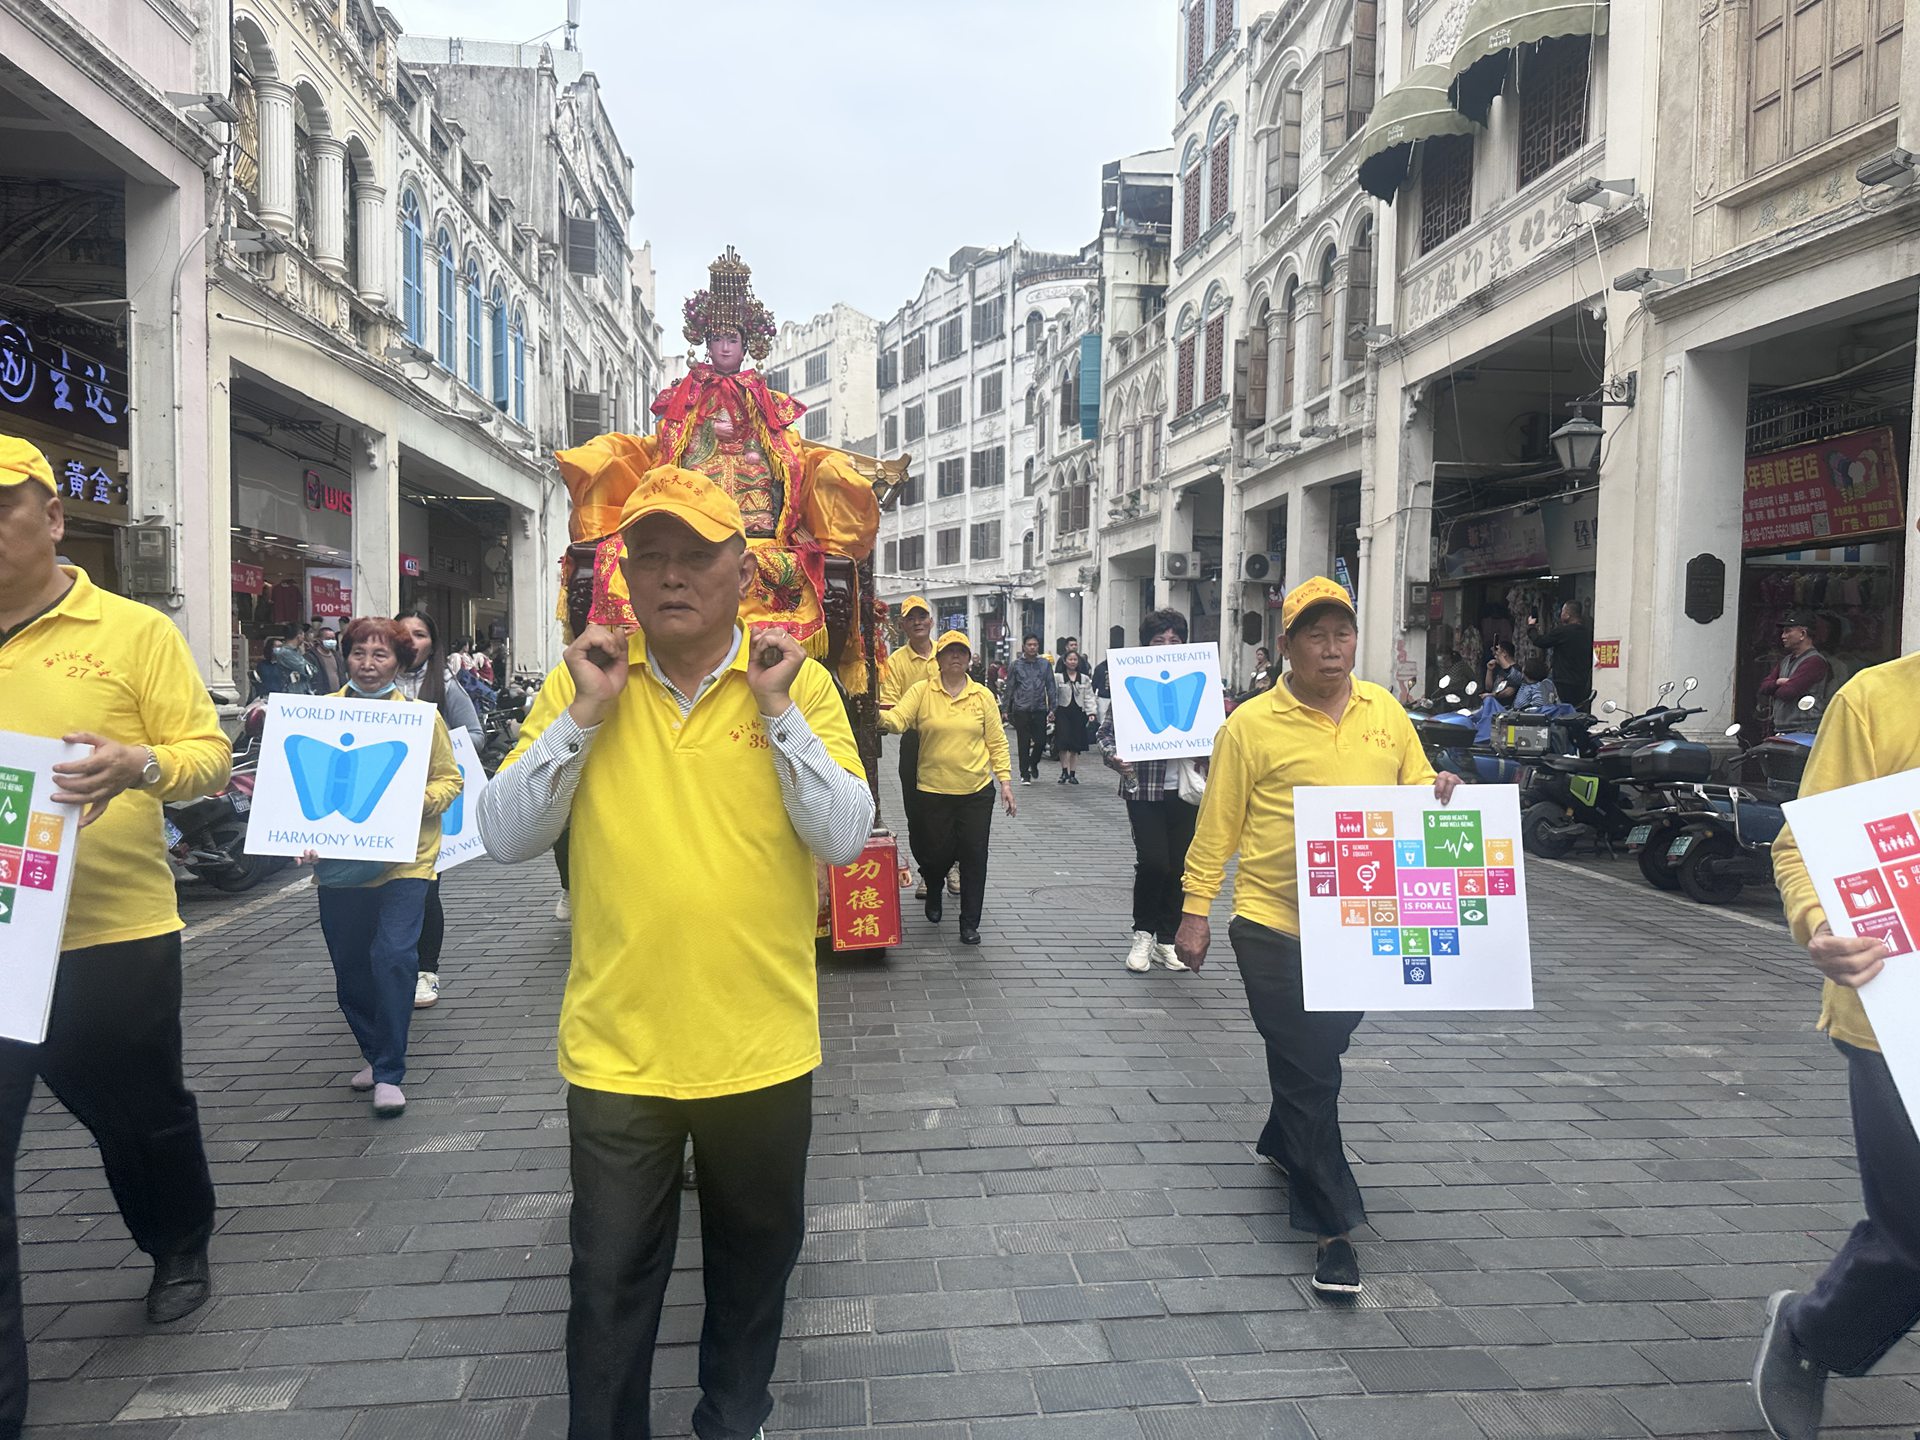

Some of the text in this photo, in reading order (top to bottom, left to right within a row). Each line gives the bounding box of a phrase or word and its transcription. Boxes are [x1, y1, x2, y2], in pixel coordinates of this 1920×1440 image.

[1743, 453, 1820, 493] 年骑楼老店
[1574, 515, 1598, 550] 经
[1116, 651, 1211, 666] WORLD INTERFAITH
[66, 666, 90, 679] 27
[280, 705, 423, 726] WORLD INTERFAITH
[749, 733, 769, 749] 39
[1130, 737, 1213, 752] HARMONY WEEK
[1375, 738, 1386, 748] 18
[1428, 815, 1435, 828] 3
[267, 830, 394, 849] HARMONY WEEK
[1341, 845, 1349, 857] 5
[1840, 880, 1847, 889] 4
[1894, 869, 1909, 888] 5
[1402, 882, 1452, 897] LOVE
[843, 859, 885, 937] 功德箱
[1404, 902, 1414, 910] IS
[1415, 902, 1434, 910] FOR
[1435, 902, 1452, 910] ALL
[1857, 923, 1865, 933] 8
